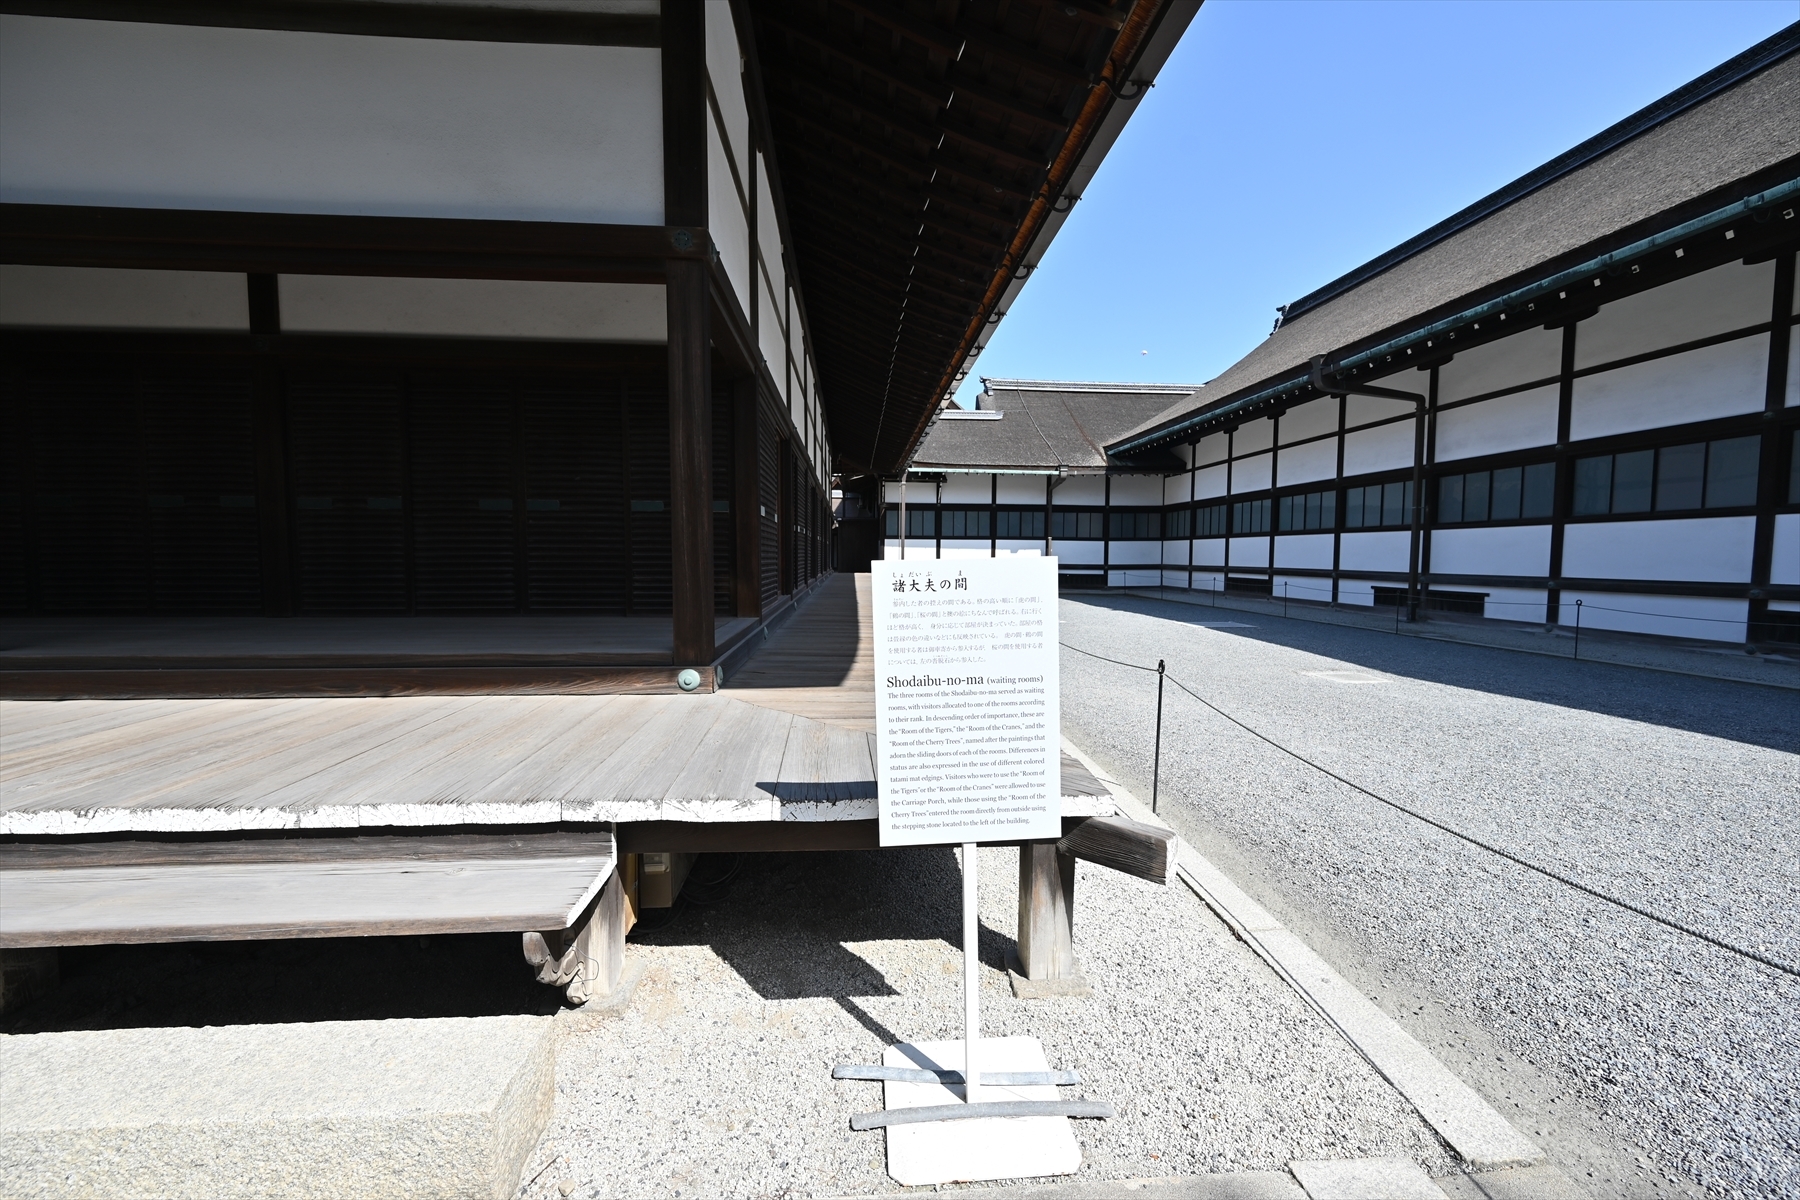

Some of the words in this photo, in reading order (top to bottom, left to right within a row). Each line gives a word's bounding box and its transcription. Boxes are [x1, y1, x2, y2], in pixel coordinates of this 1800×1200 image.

[891, 577, 968, 593] 諸大夫の間
[886, 674, 984, 688] Shodaibu-no-ma
[986, 676, 1017, 686] (waiting
[1018, 675, 1043, 684] rooms)
[1009, 735, 1033, 743] paintings
[932, 762, 960, 770] expressed
